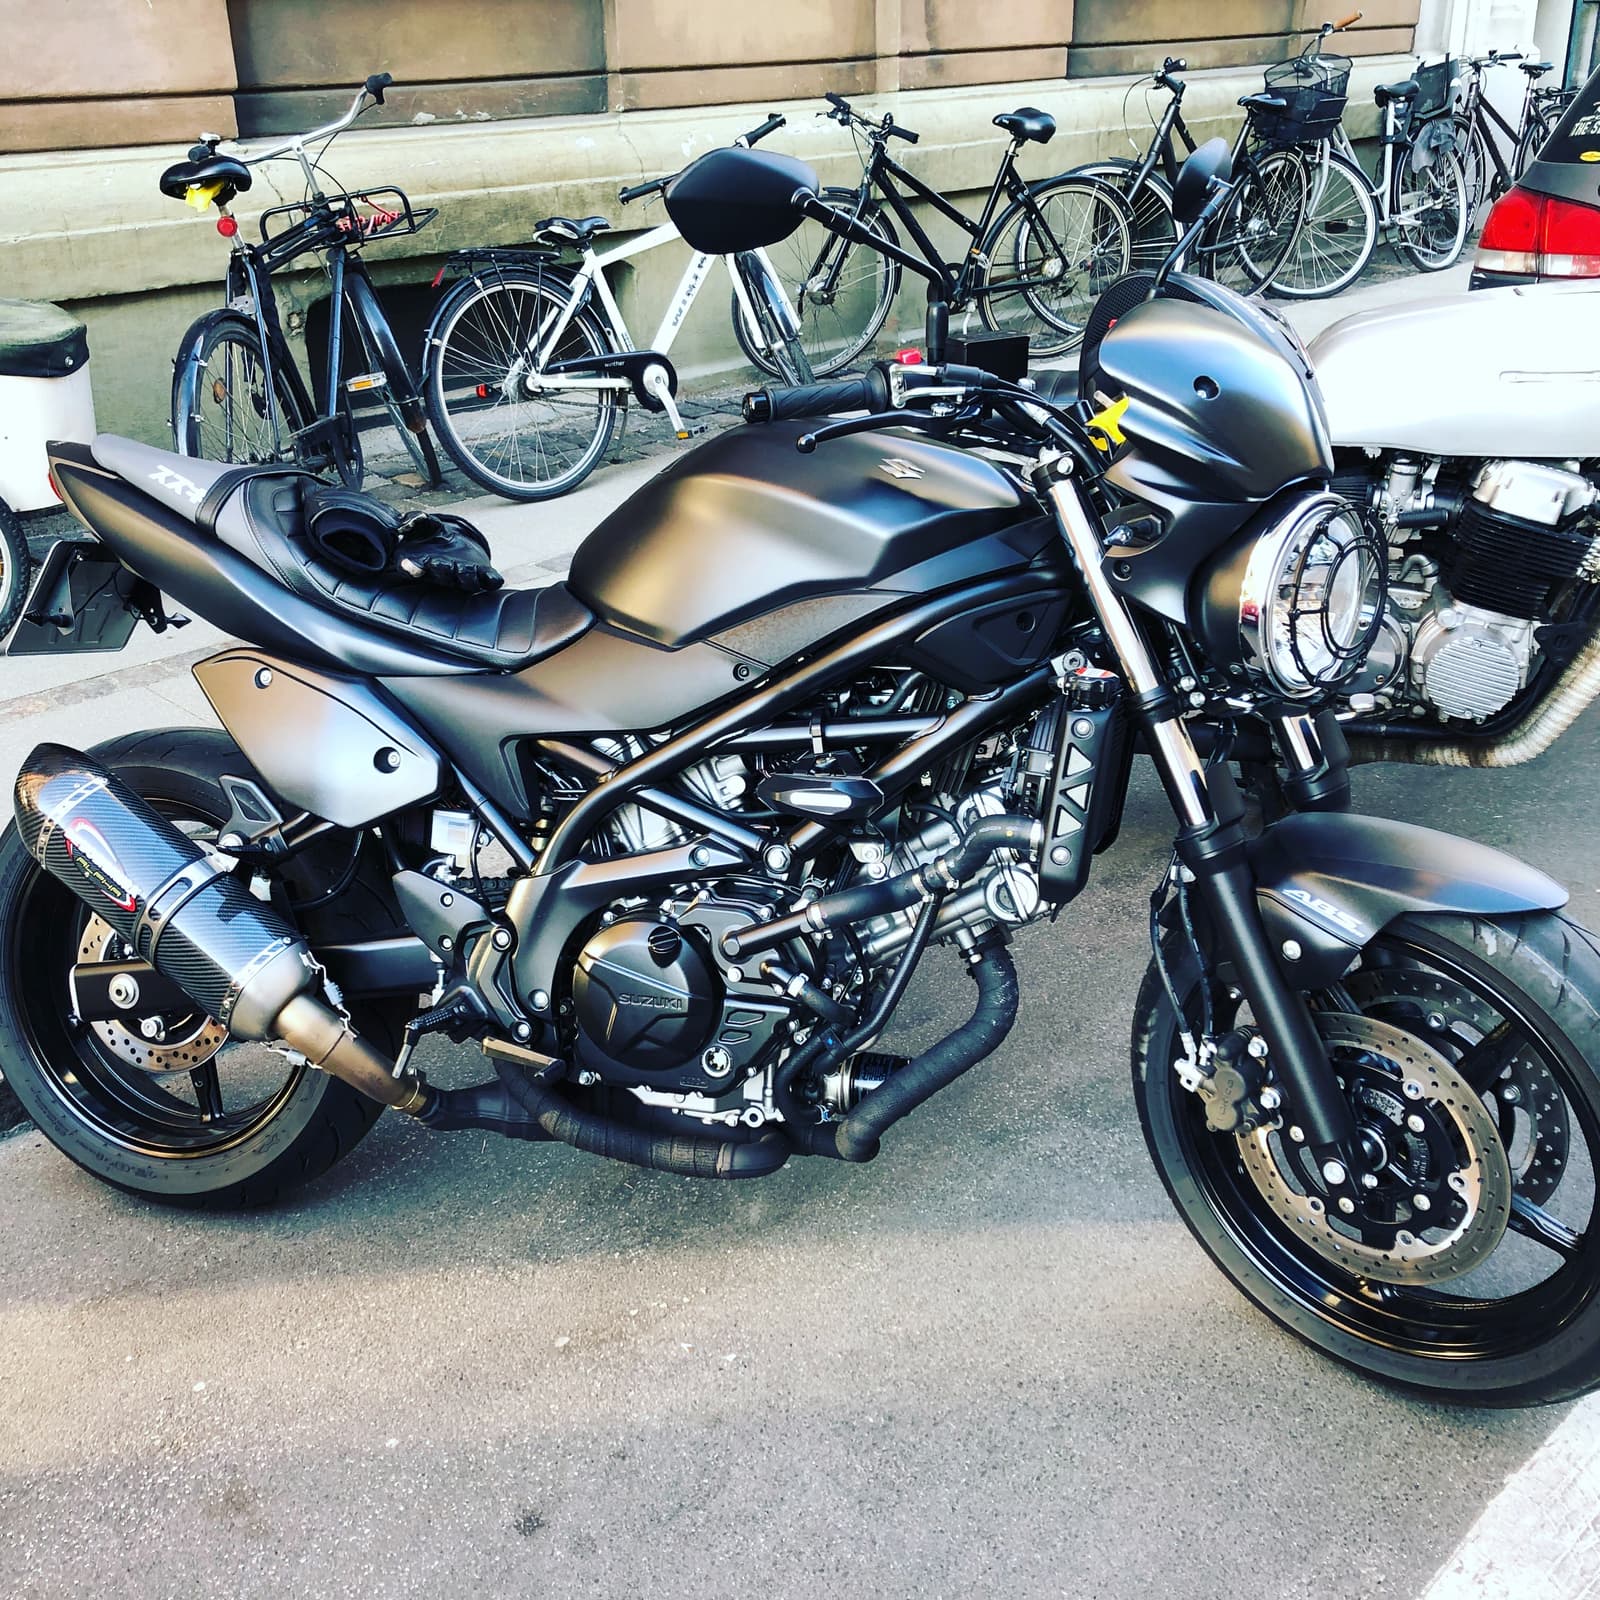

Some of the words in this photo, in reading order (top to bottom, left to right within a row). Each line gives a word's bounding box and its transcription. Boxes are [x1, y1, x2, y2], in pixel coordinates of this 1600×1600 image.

[76, 857, 122, 897] ALPHA
[1281, 888, 1366, 939] ABS
[618, 992, 683, 1010] SUZUKI
